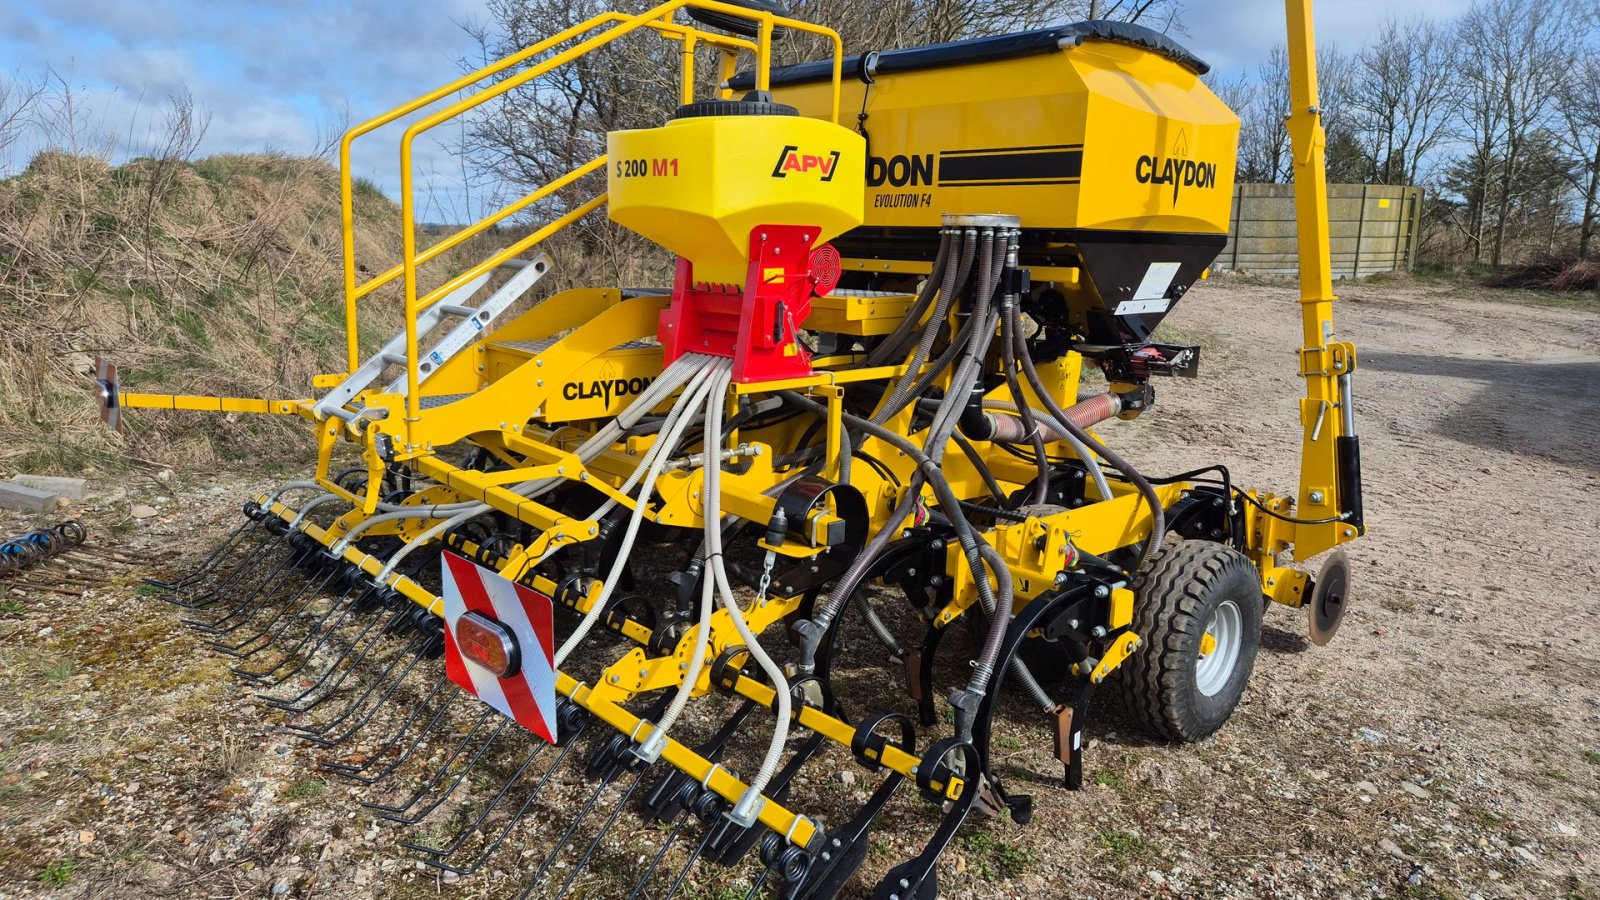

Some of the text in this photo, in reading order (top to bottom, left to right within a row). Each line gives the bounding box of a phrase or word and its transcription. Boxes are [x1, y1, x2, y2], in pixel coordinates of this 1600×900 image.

[617, 158, 678, 177] S 200 M1
[1136, 155, 1216, 208] CLAYDON
[874, 193, 932, 208] EVOLUTION F4
